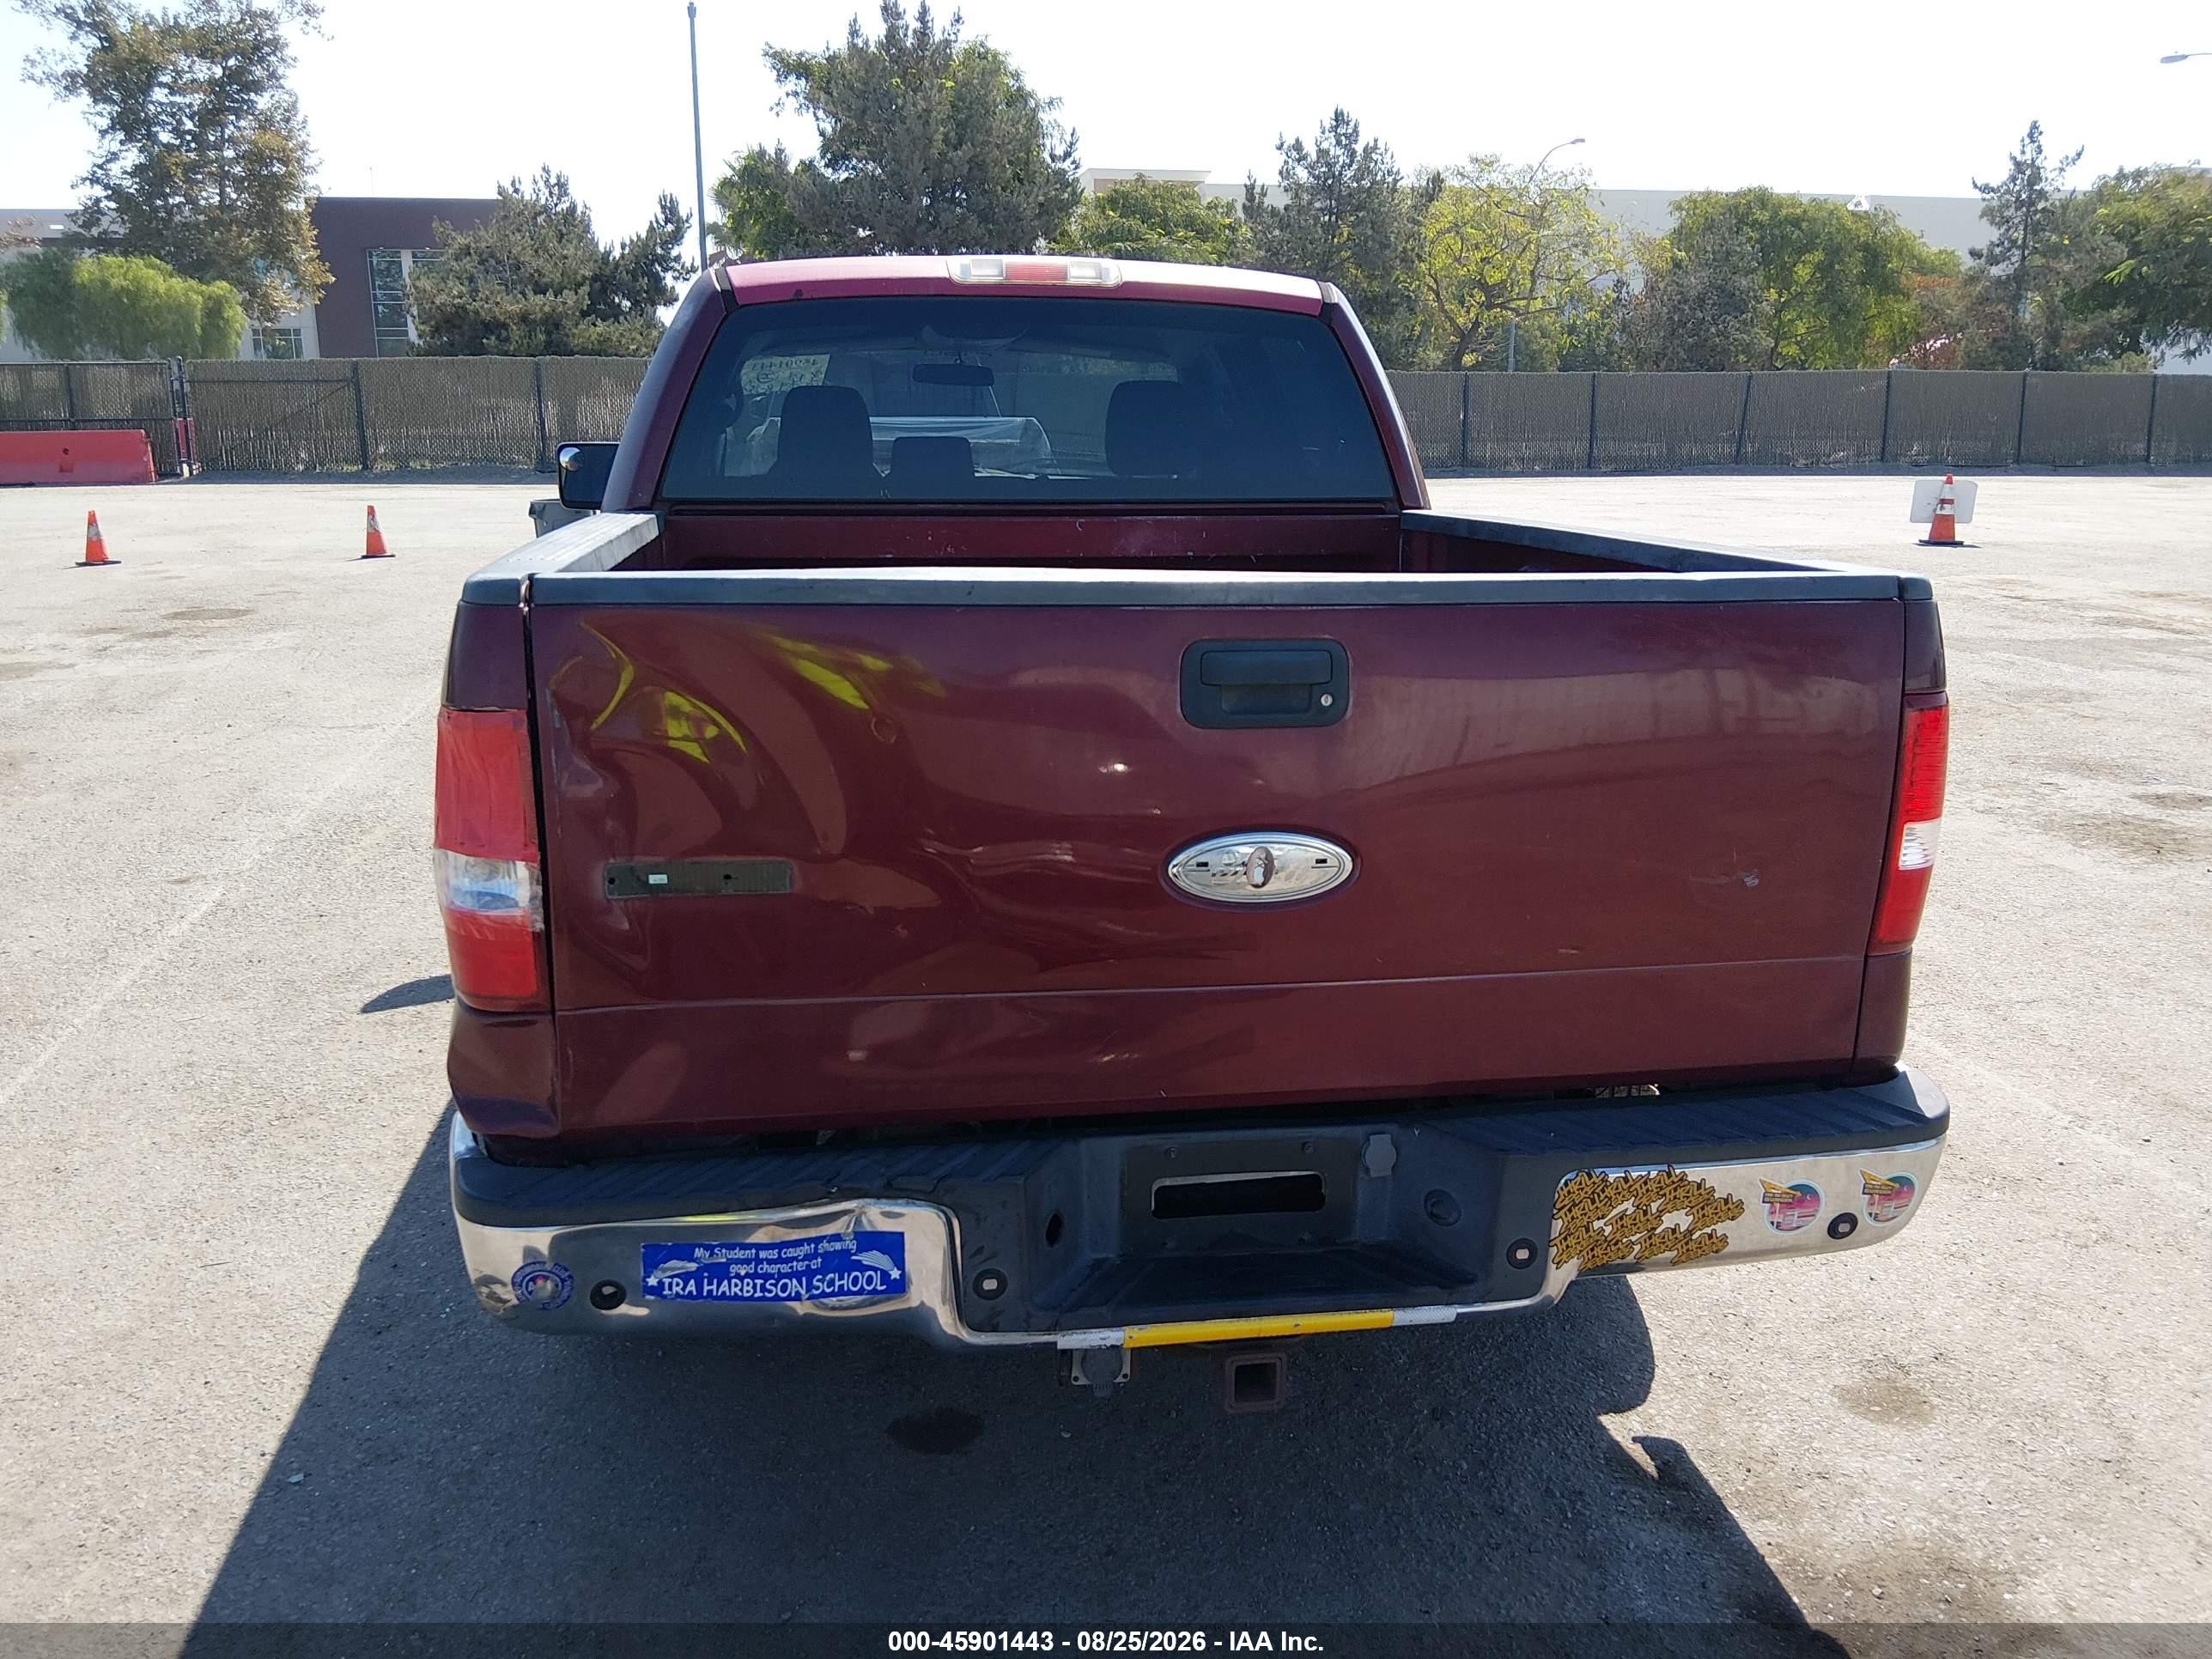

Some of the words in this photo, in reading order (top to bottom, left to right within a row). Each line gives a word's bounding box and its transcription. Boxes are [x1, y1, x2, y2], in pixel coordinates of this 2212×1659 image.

[1658, 1178, 1715, 1202] THRILL
[1553, 1191, 1609, 1224] THRILL
[1604, 1204, 1662, 1231] THRILL
[1686, 1193, 1744, 1220] THRILL
[1548, 1221, 1604, 1251] THRILL
[1632, 1224, 1691, 1251] THRILL
[1669, 1229, 1728, 1255] THRILL
[694, 1247, 710, 1259] My
[714, 1246, 756, 1259] Student
[759, 1249, 778, 1259] was
[781, 1244, 814, 1262] caught
[817, 1238, 857, 1253] showing
[730, 1262, 754, 1276] good
[757, 1260, 806, 1278] character
[809, 1259, 822, 1269] at
[662, 1278, 697, 1296] IRA
[702, 1277, 807, 1298] HARBISON
[812, 1271, 887, 1295] SCHOOL
